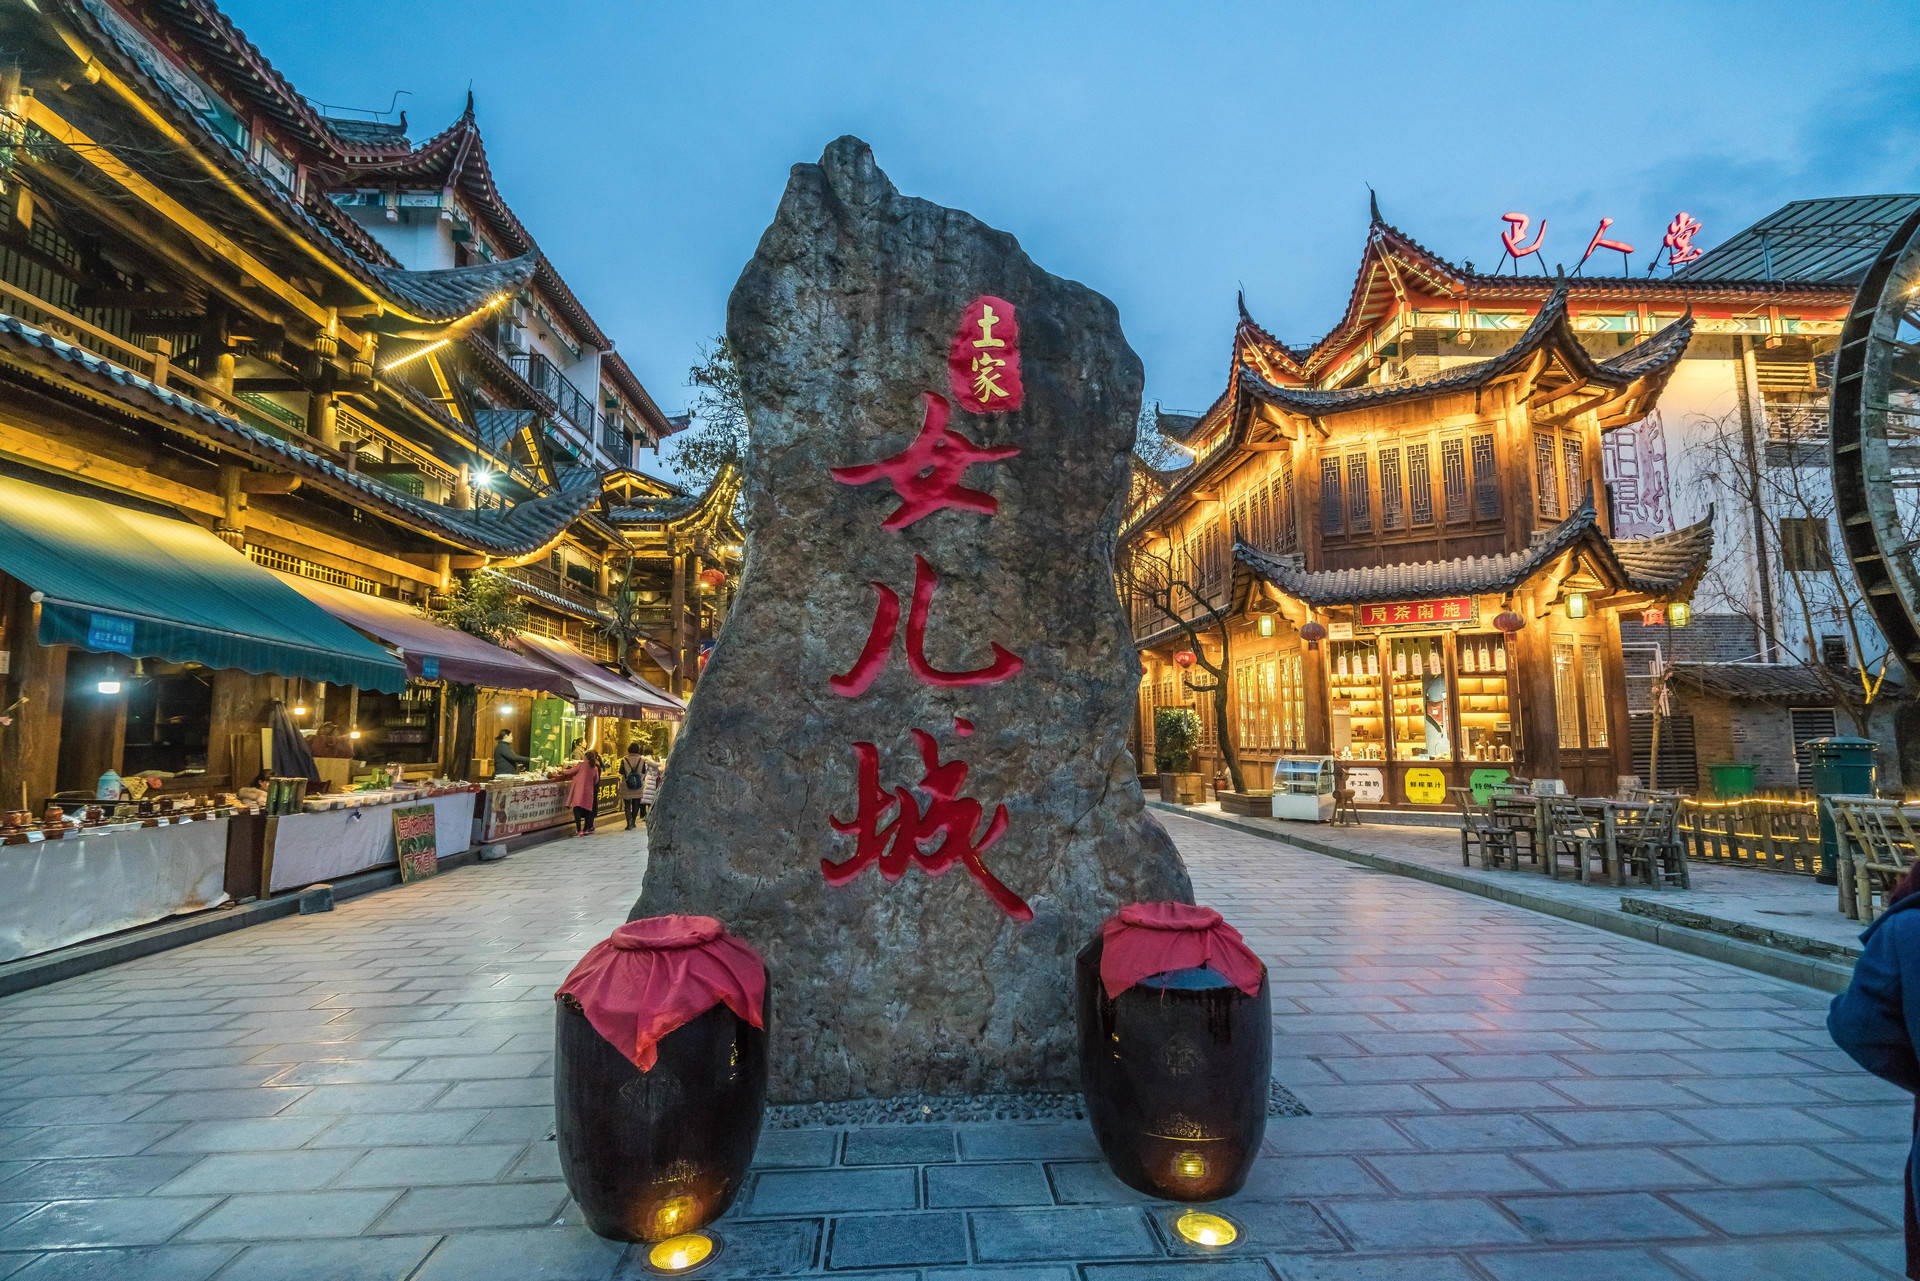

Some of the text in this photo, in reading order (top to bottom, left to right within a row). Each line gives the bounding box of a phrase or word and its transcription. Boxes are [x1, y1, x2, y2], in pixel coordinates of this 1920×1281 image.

[1502, 212, 1703, 265] 巴人堂
[972, 304, 1010, 403] 土家
[818, 390, 1034, 922] 女儿城
